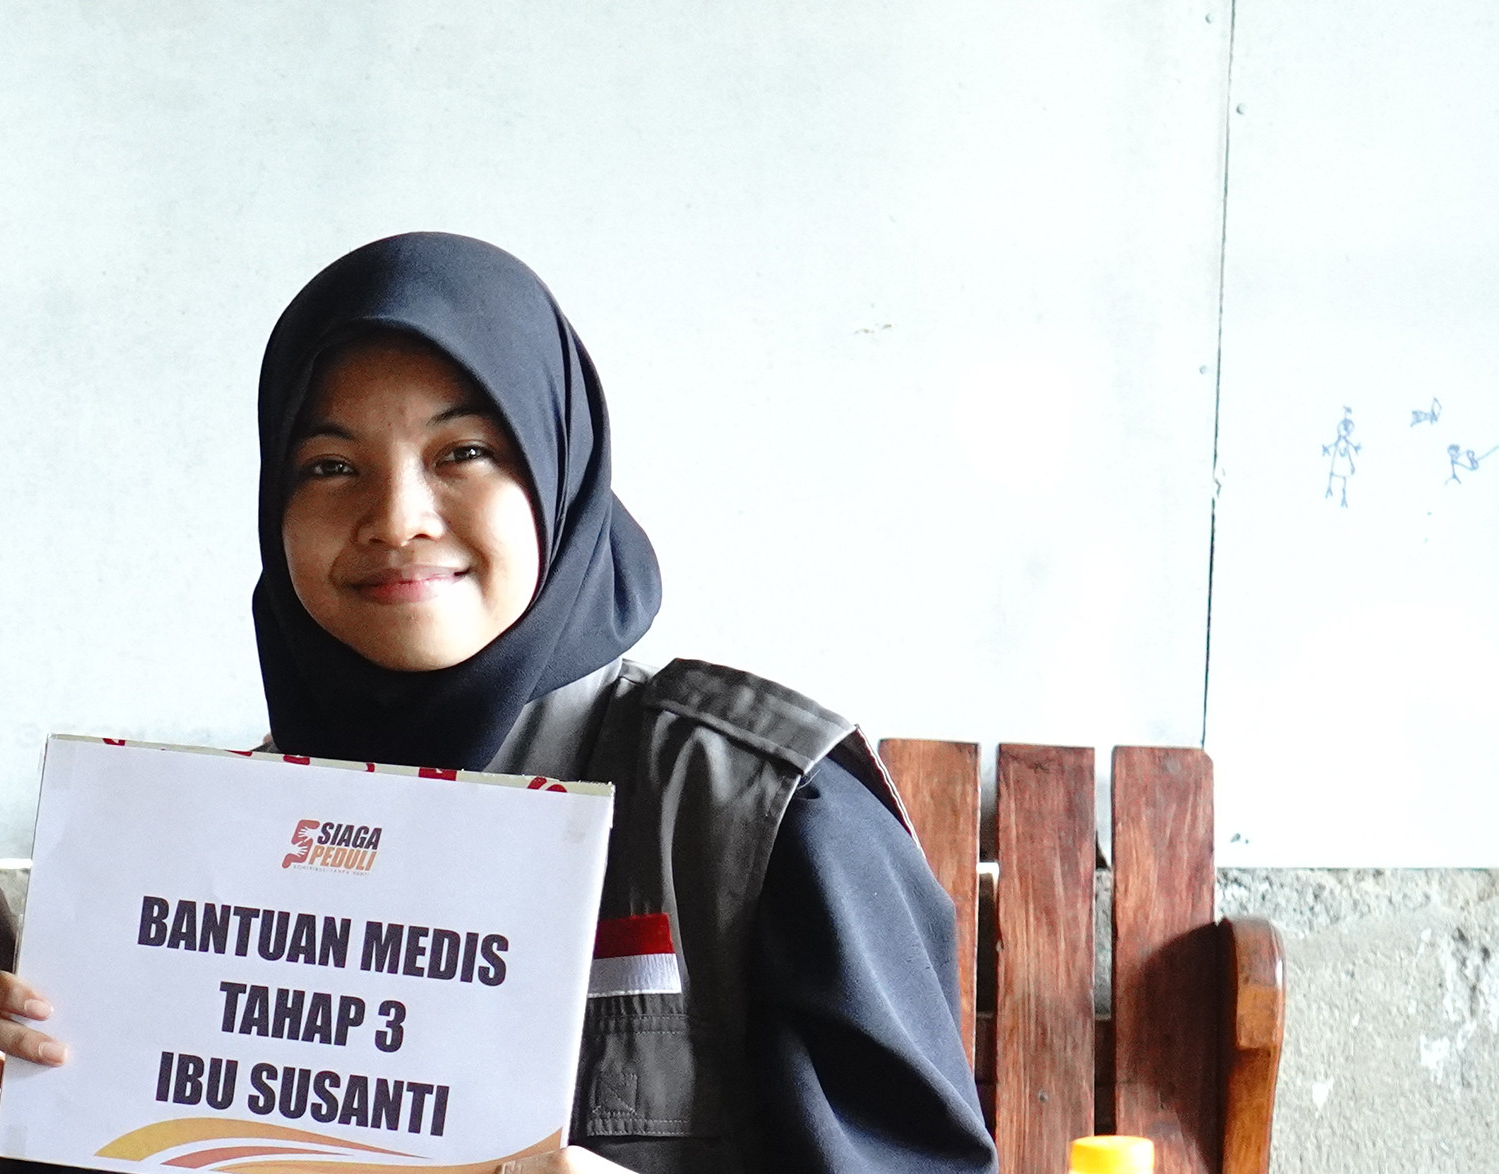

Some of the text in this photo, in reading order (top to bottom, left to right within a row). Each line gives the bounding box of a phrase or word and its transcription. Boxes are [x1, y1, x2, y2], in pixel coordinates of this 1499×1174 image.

[309, 845, 377, 871] PEDULI
[317, 822, 382, 850] SIAGA
[137, 895, 510, 986] BANTUAN MEDIS
[220, 981, 407, 1052] TAHAP 3
[155, 1052, 450, 1137] IBU SUSANTI
